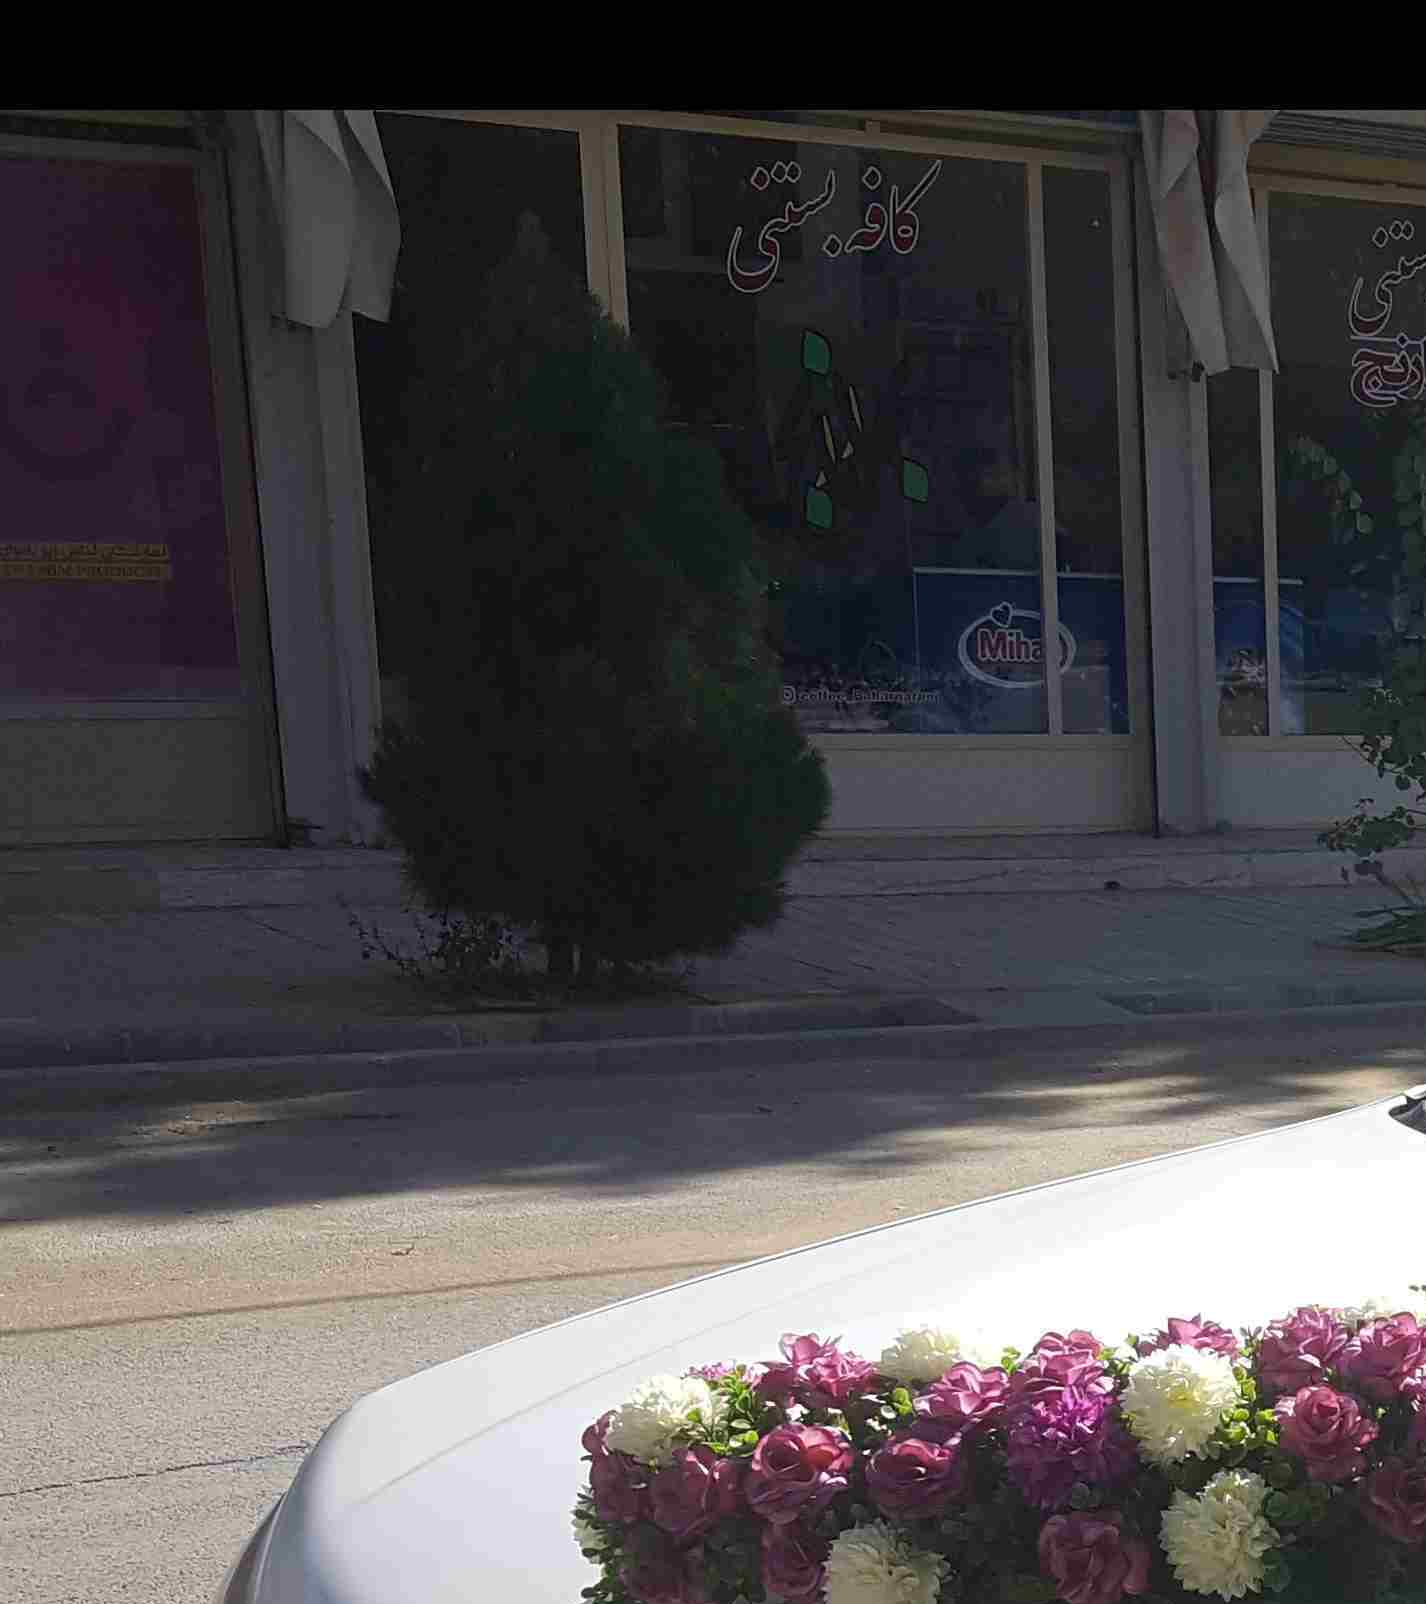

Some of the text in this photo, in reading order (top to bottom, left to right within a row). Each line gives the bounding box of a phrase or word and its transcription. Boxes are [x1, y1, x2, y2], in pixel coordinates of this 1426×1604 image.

[727, 159, 943, 293] کافه بستنی
[976, 625, 1064, 663] Miha
